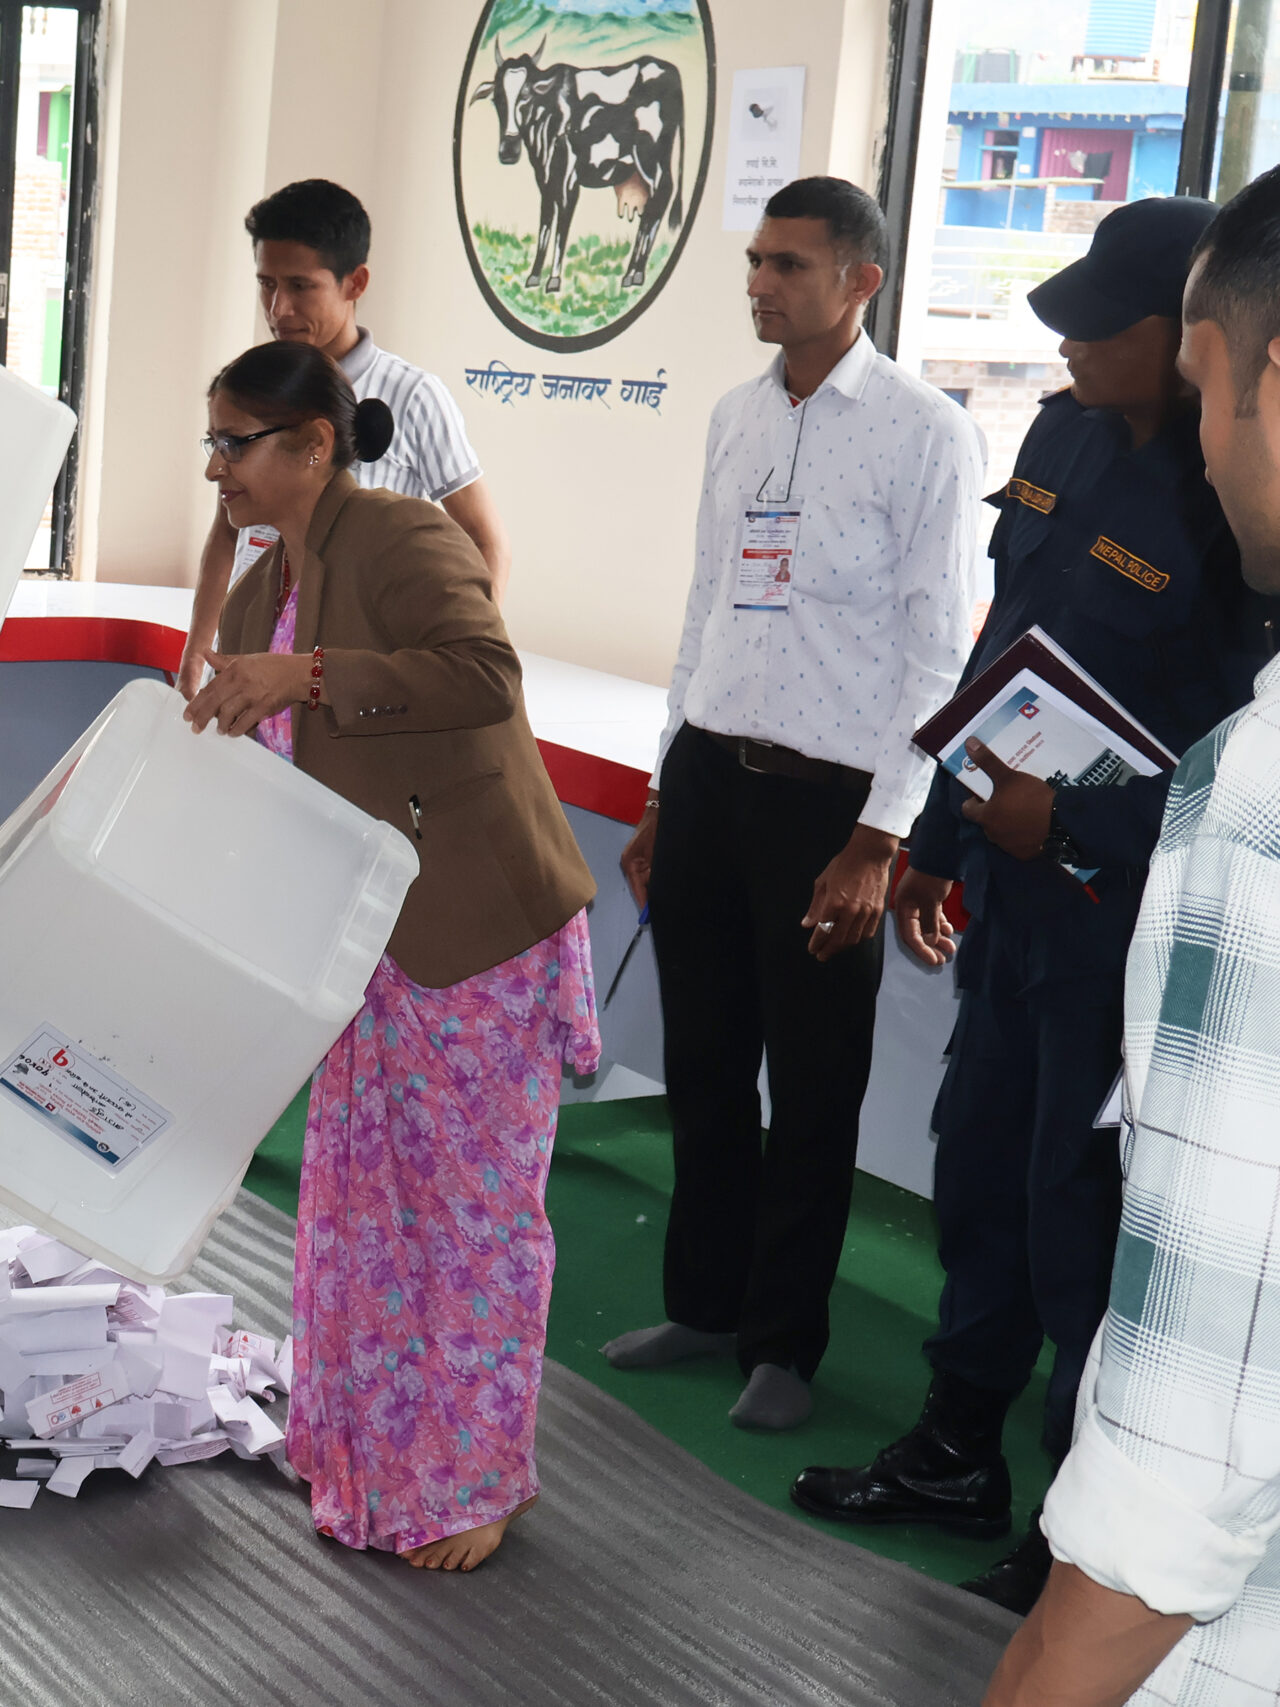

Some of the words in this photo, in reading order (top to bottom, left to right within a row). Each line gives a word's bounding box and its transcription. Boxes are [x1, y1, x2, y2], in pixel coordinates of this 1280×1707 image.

[464, 360, 536, 408] राष्ट्रिय
[540, 374, 613, 409] जनावर
[620, 368, 668, 416] गाई
[1098, 542, 1127, 569] NEPAL
[1127, 560, 1162, 588] POLICE
